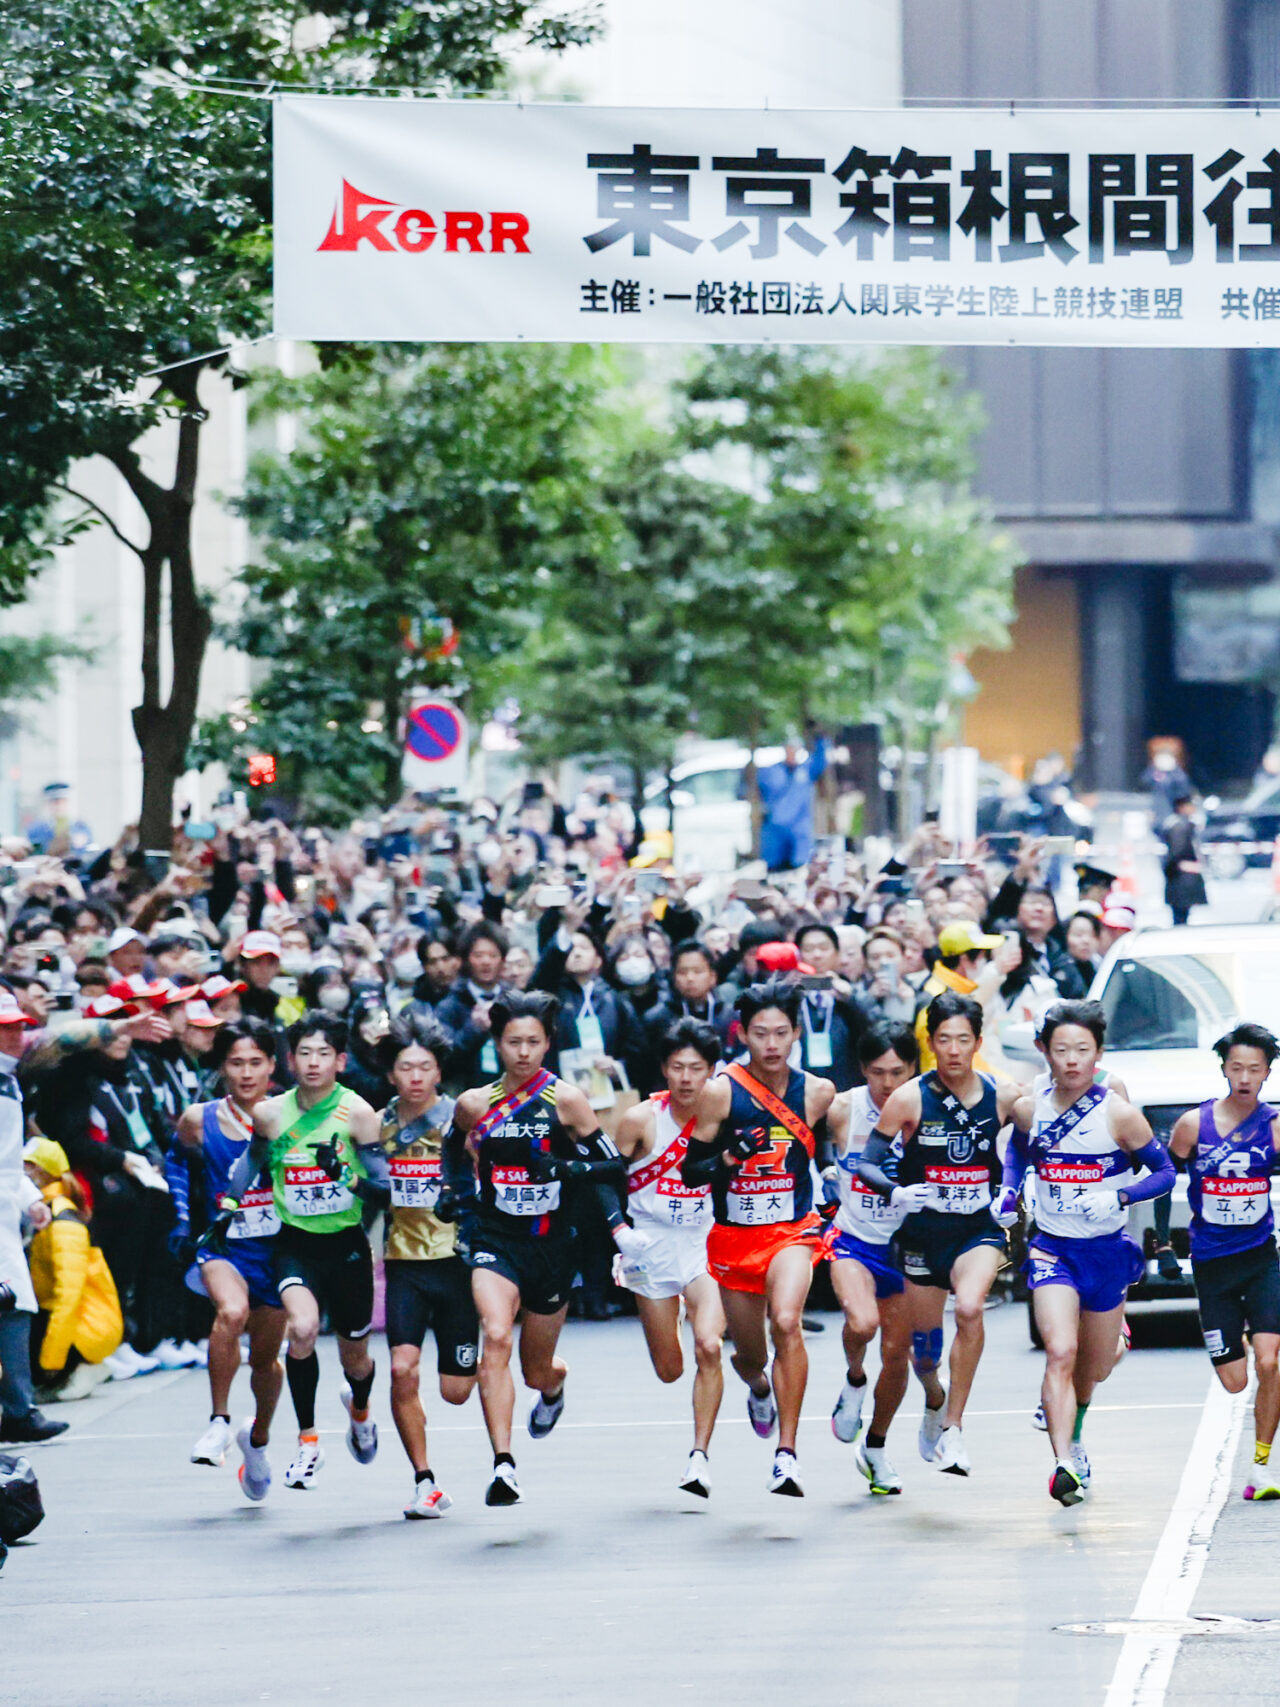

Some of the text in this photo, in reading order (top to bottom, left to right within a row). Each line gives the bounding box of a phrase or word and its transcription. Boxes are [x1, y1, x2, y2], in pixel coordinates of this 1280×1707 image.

[940, 1170, 990, 1182] SAPPORO
[1048, 1167, 1100, 1180] SAPPORO
[740, 1177, 793, 1192] SAPPORO
[1218, 1181, 1268, 1194] SAPPORO
[294, 1184, 341, 1202] 大東大
[504, 1187, 550, 1202] 創価大
[936, 1185, 981, 1201] 東洋大
[739, 1194, 782, 1212] 法大
[1216, 1198, 1256, 1212] 立大
